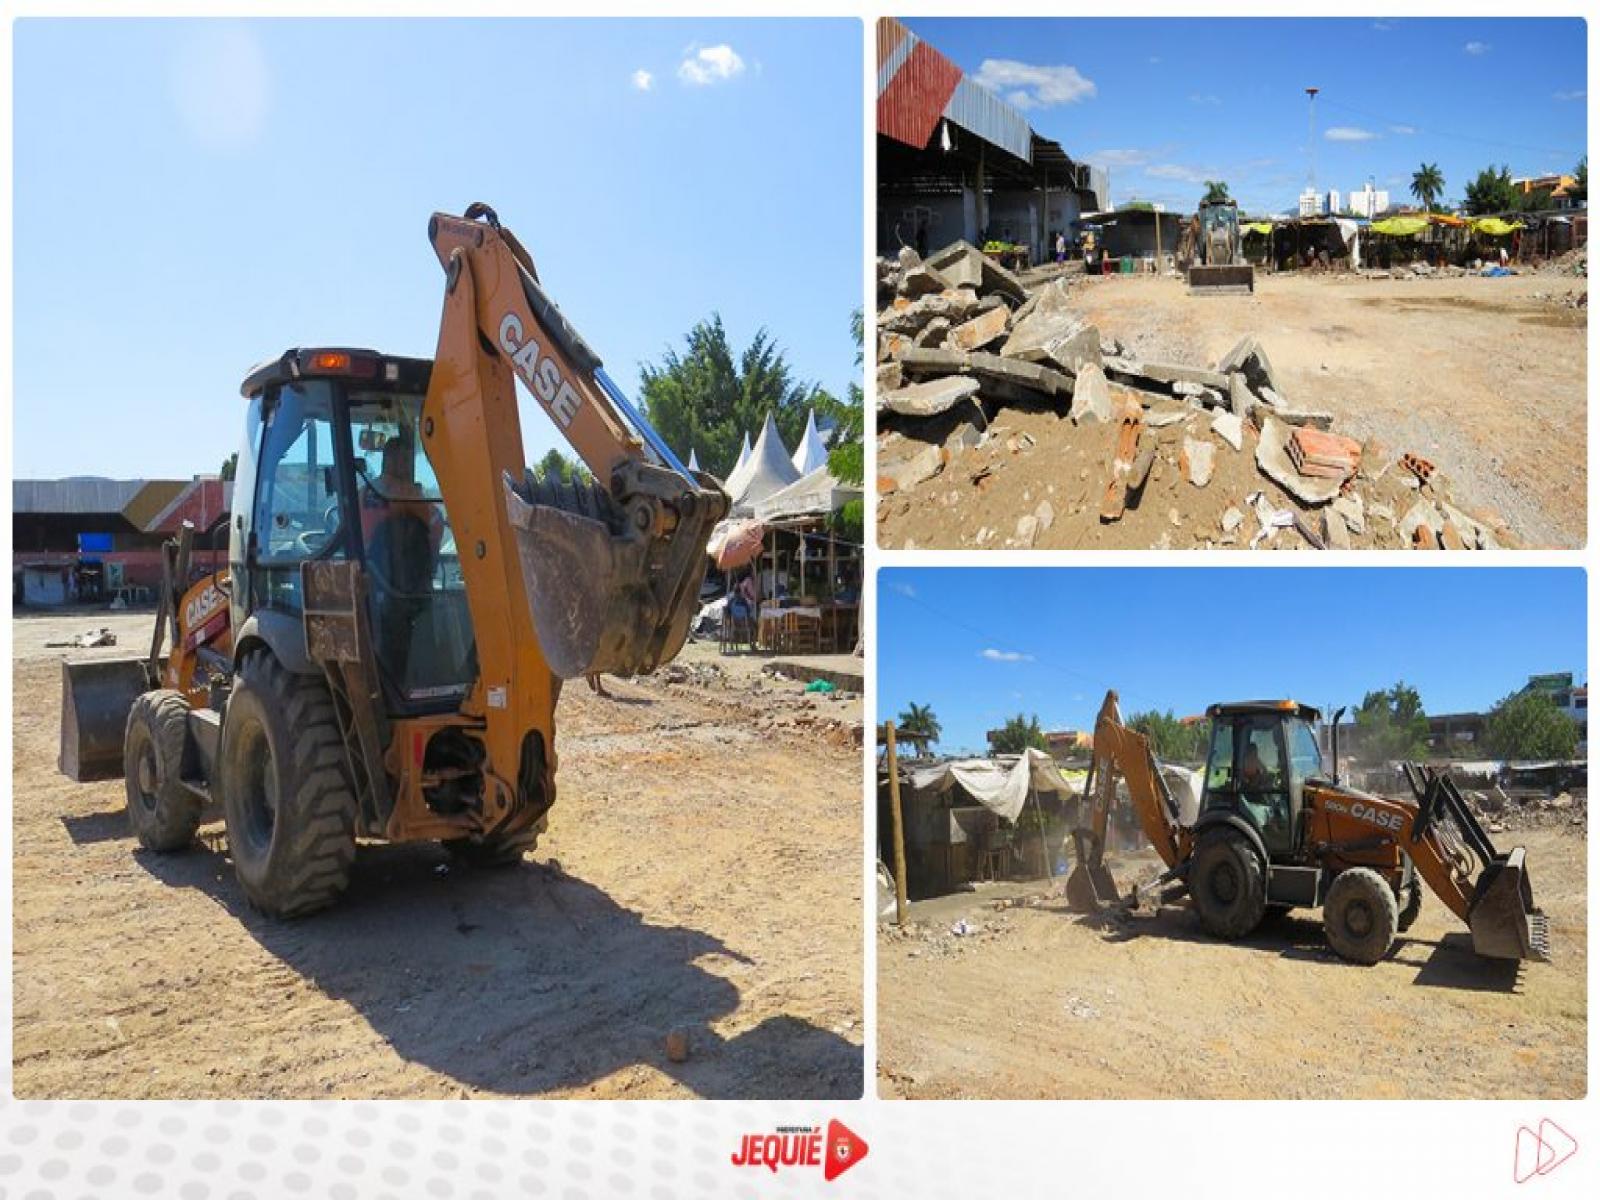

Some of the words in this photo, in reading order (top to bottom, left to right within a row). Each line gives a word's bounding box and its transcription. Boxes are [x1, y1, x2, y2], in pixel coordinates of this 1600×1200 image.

[499, 312, 581, 428] CASE
[185, 584, 218, 628] CASE
[1351, 803, 1403, 830] CASE
